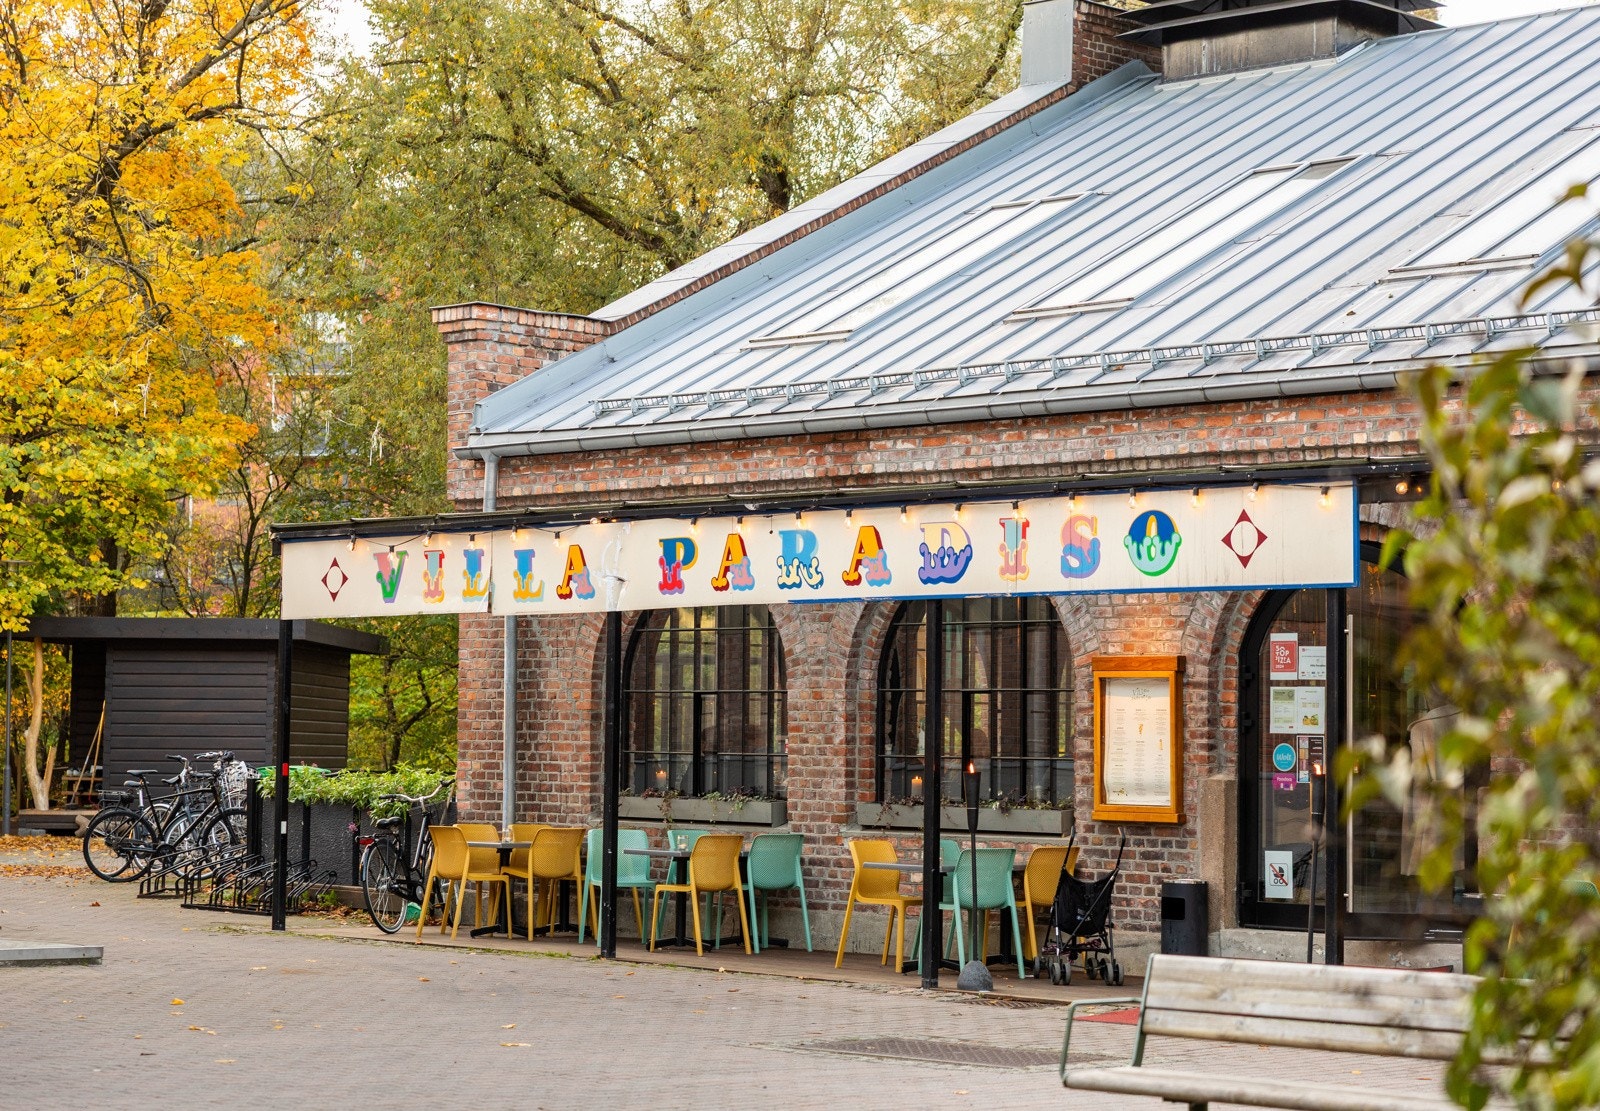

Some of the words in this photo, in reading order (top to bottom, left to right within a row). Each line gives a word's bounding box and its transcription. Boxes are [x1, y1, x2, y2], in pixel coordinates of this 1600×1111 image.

[373, 544, 596, 604] VILLA
[658, 510, 1182, 596] PARADISO
[1276, 753, 1292, 761] Wolt
